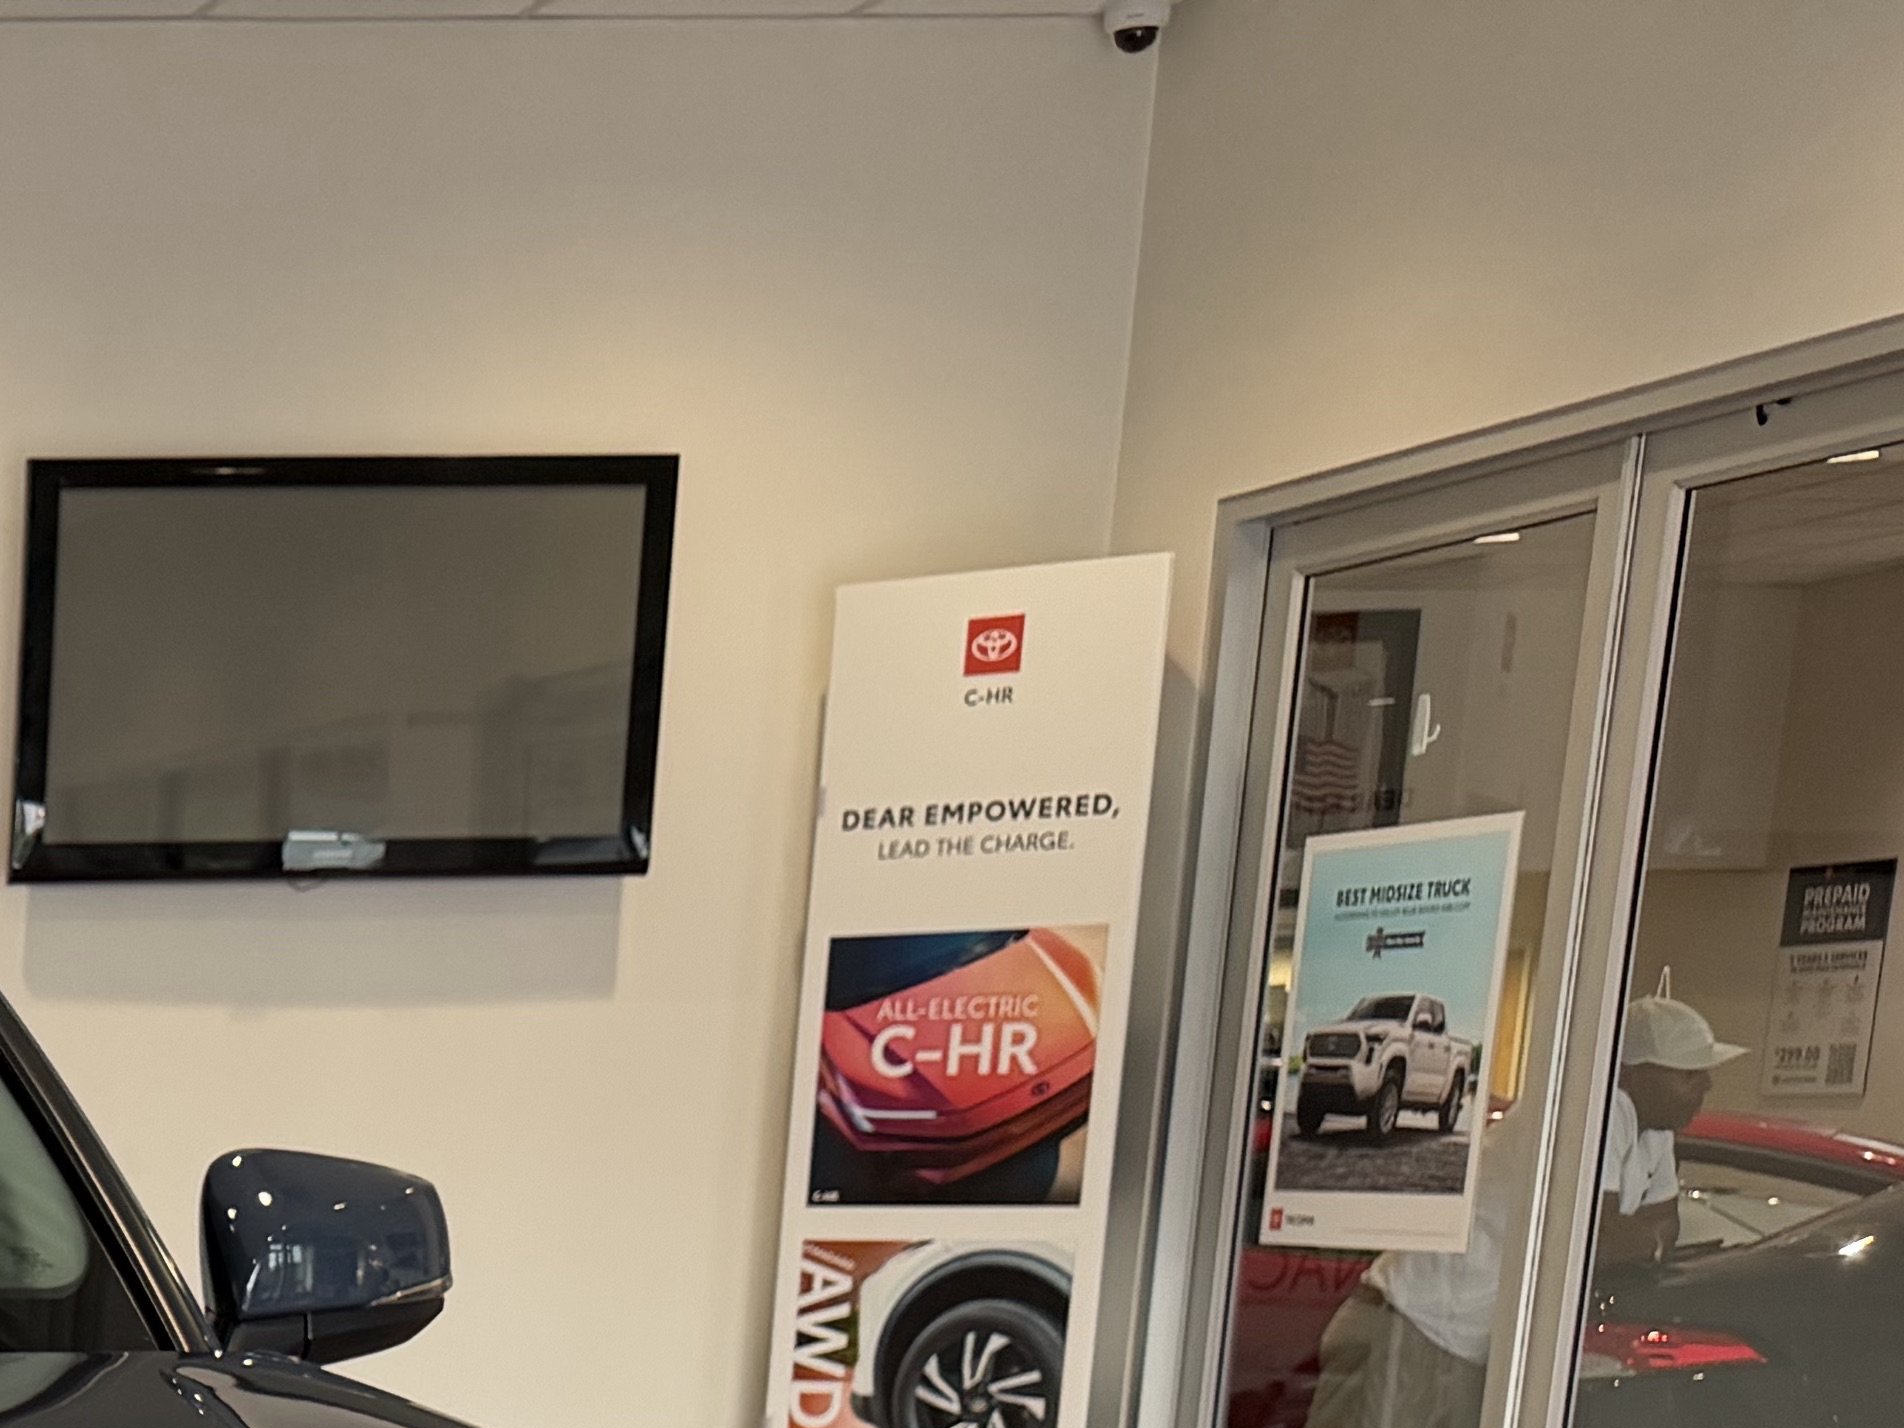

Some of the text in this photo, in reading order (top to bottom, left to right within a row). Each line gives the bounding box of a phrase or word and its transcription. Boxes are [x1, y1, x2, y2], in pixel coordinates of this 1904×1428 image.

[963, 686, 1015, 707] C-HR
[841, 793, 1121, 832] DEAR EMPOWERED,
[878, 830, 1076, 861] LEAD THE CHARGE.
[1336, 877, 1472, 907] BEST MIDSIZE TRUCK
[1804, 882, 1871, 905] PREPAID
[1800, 915, 1866, 936] PROGRAM
[876, 994, 1039, 1022] ALL-ELECTRIC
[870, 1021, 1038, 1079] C-HR
